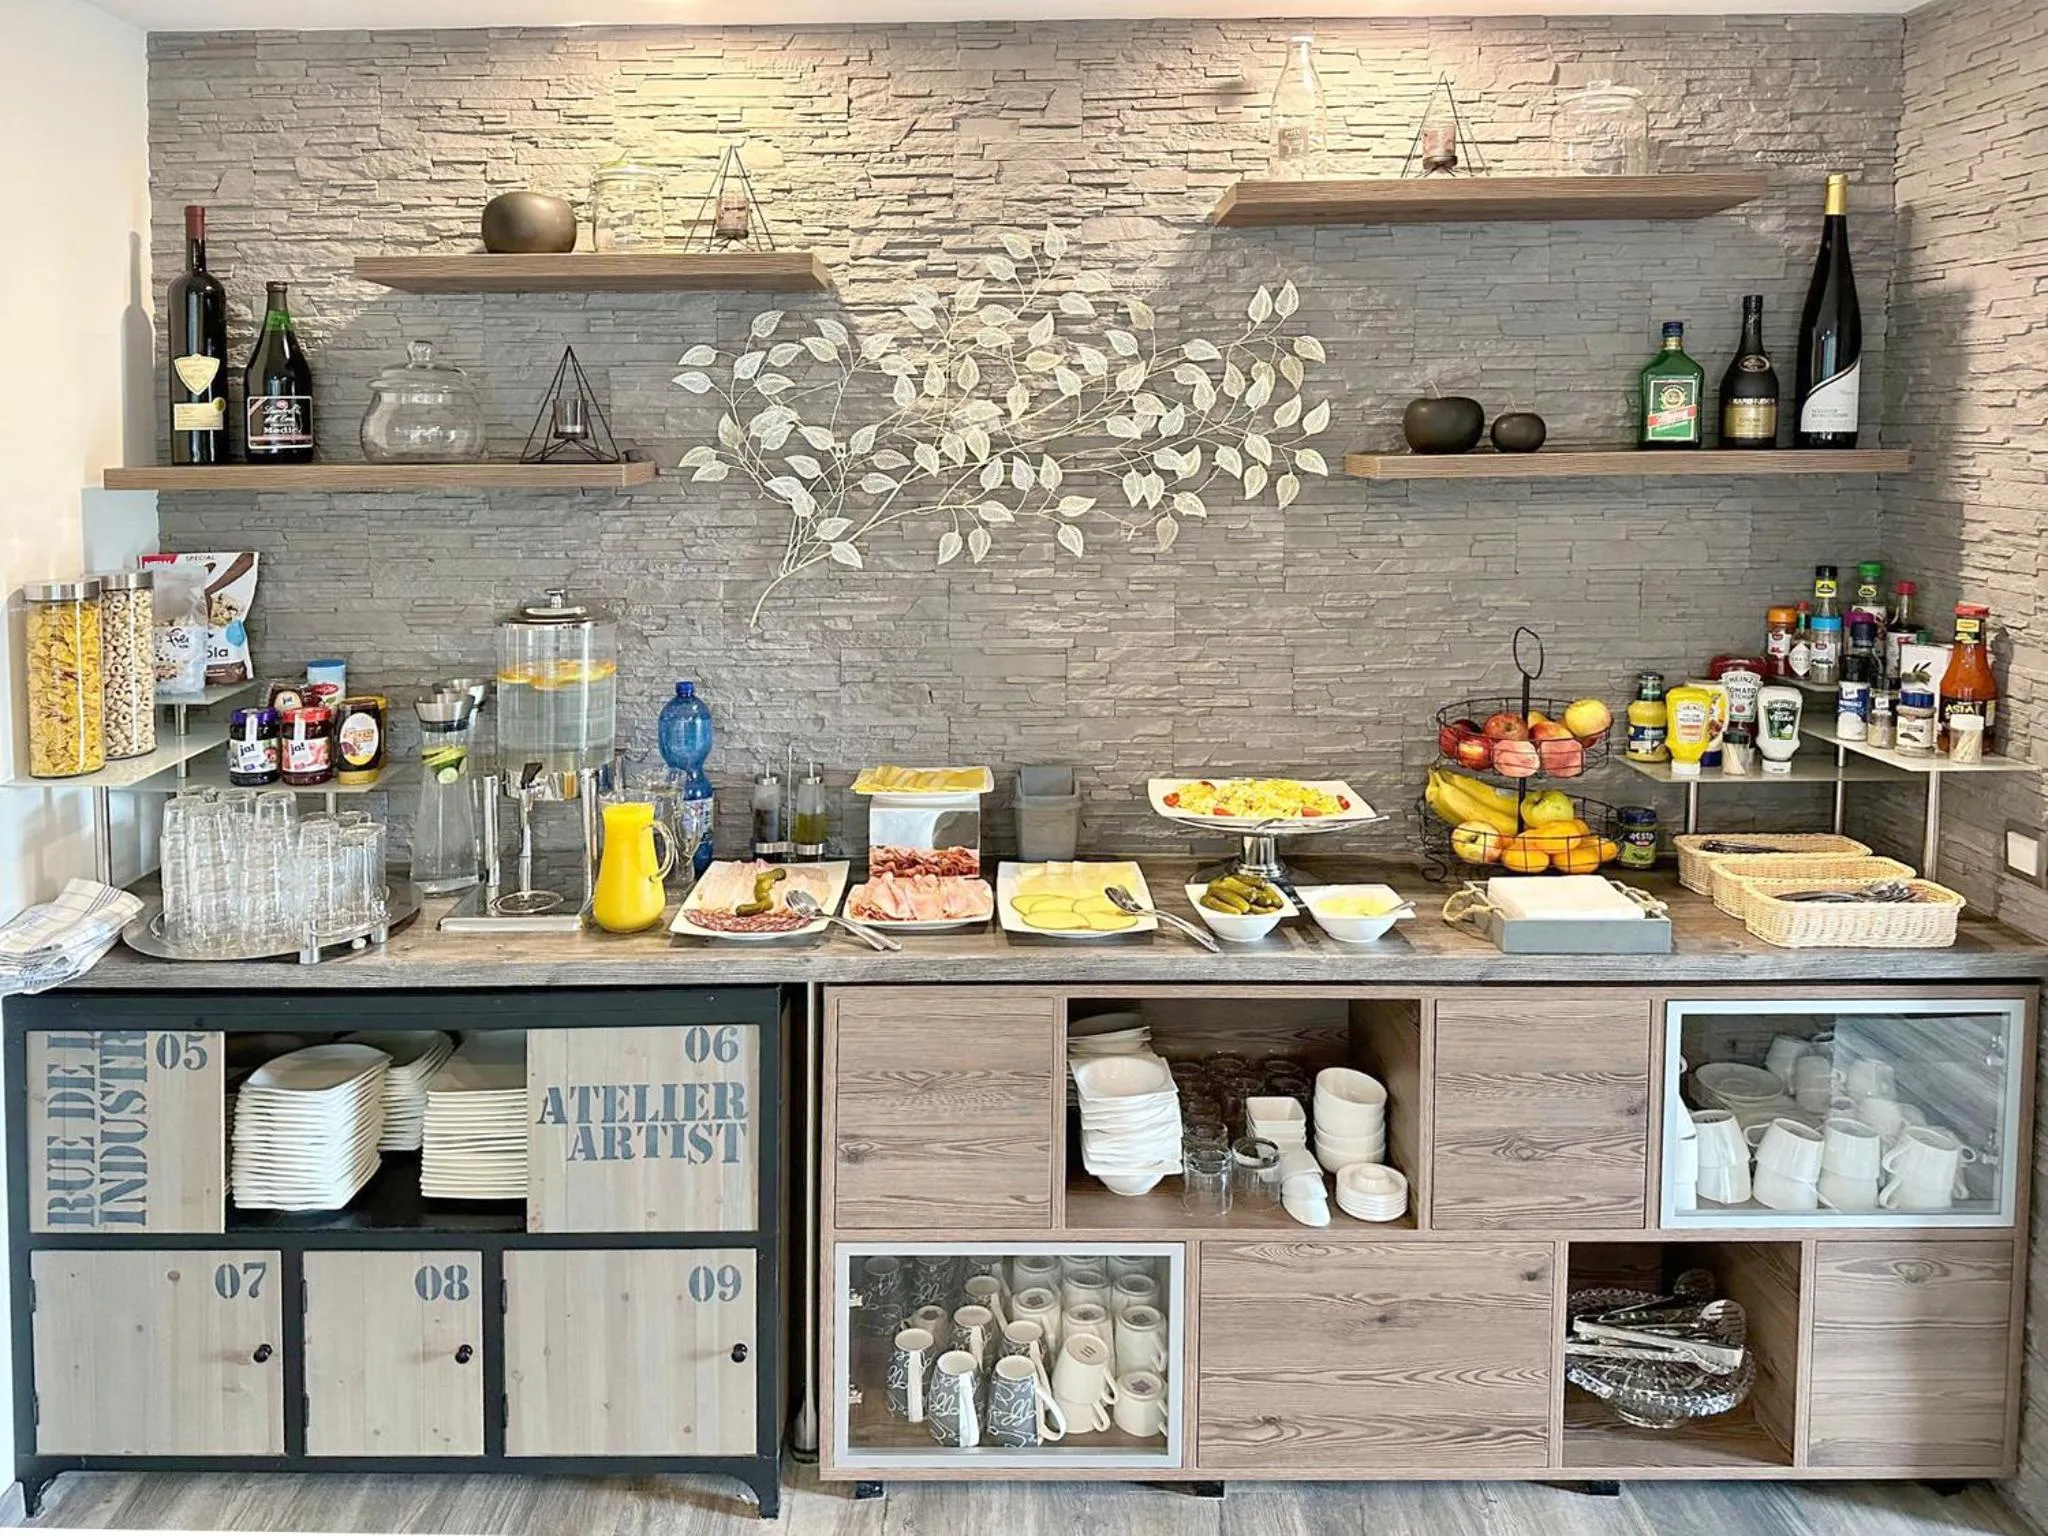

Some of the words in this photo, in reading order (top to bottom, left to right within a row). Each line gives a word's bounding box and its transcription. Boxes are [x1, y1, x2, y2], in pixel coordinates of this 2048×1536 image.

[1729, 676, 1754, 684] HEINZ
[1945, 704, 1975, 714] ASIA
[240, 743, 255, 757] ja!
[290, 742, 305, 756] ja!
[156, 1033, 208, 1071] 05
[684, 1026, 739, 1063] 06
[47, 1064, 95, 1121] DE
[535, 1082, 749, 1124] ATELIER
[566, 1123, 748, 1165] ARTIST
[47, 1135, 95, 1227] RUE
[214, 1262, 267, 1299] 07
[414, 1264, 470, 1301] 08
[688, 1264, 742, 1302] 09
